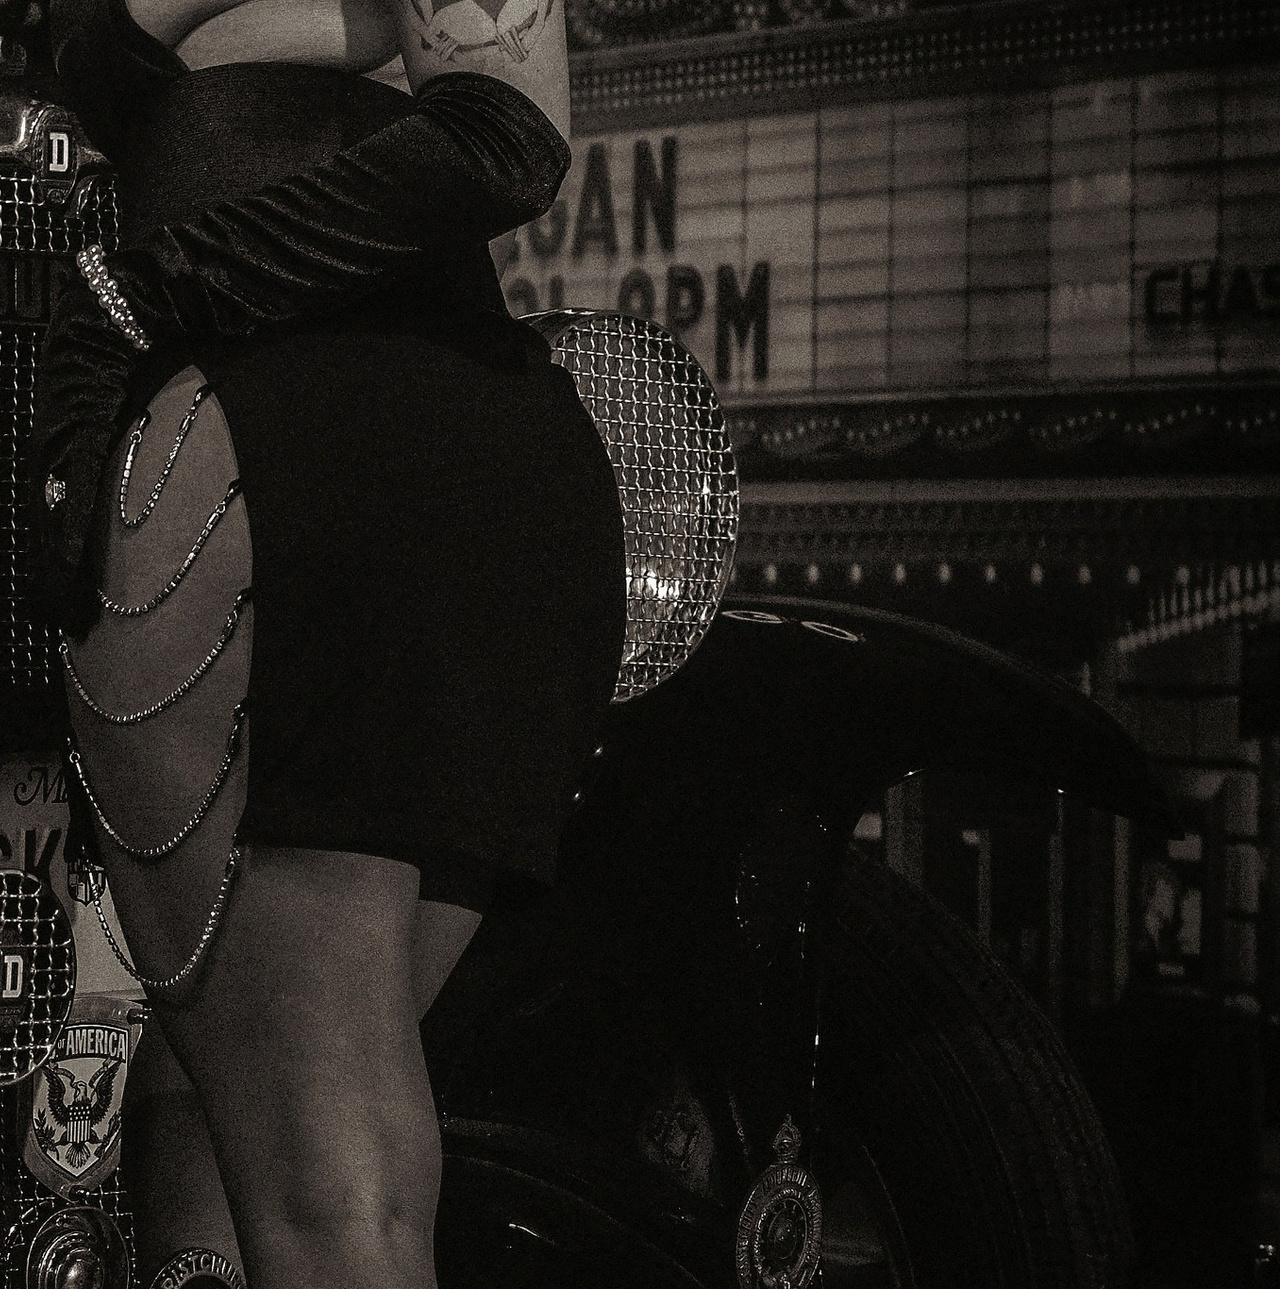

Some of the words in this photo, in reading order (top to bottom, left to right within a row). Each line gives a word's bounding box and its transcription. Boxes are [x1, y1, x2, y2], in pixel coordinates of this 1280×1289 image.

[49, 132, 69, 172] D
[2, 955, 24, 998] D
[65, 1028, 126, 1061] AMERICA
